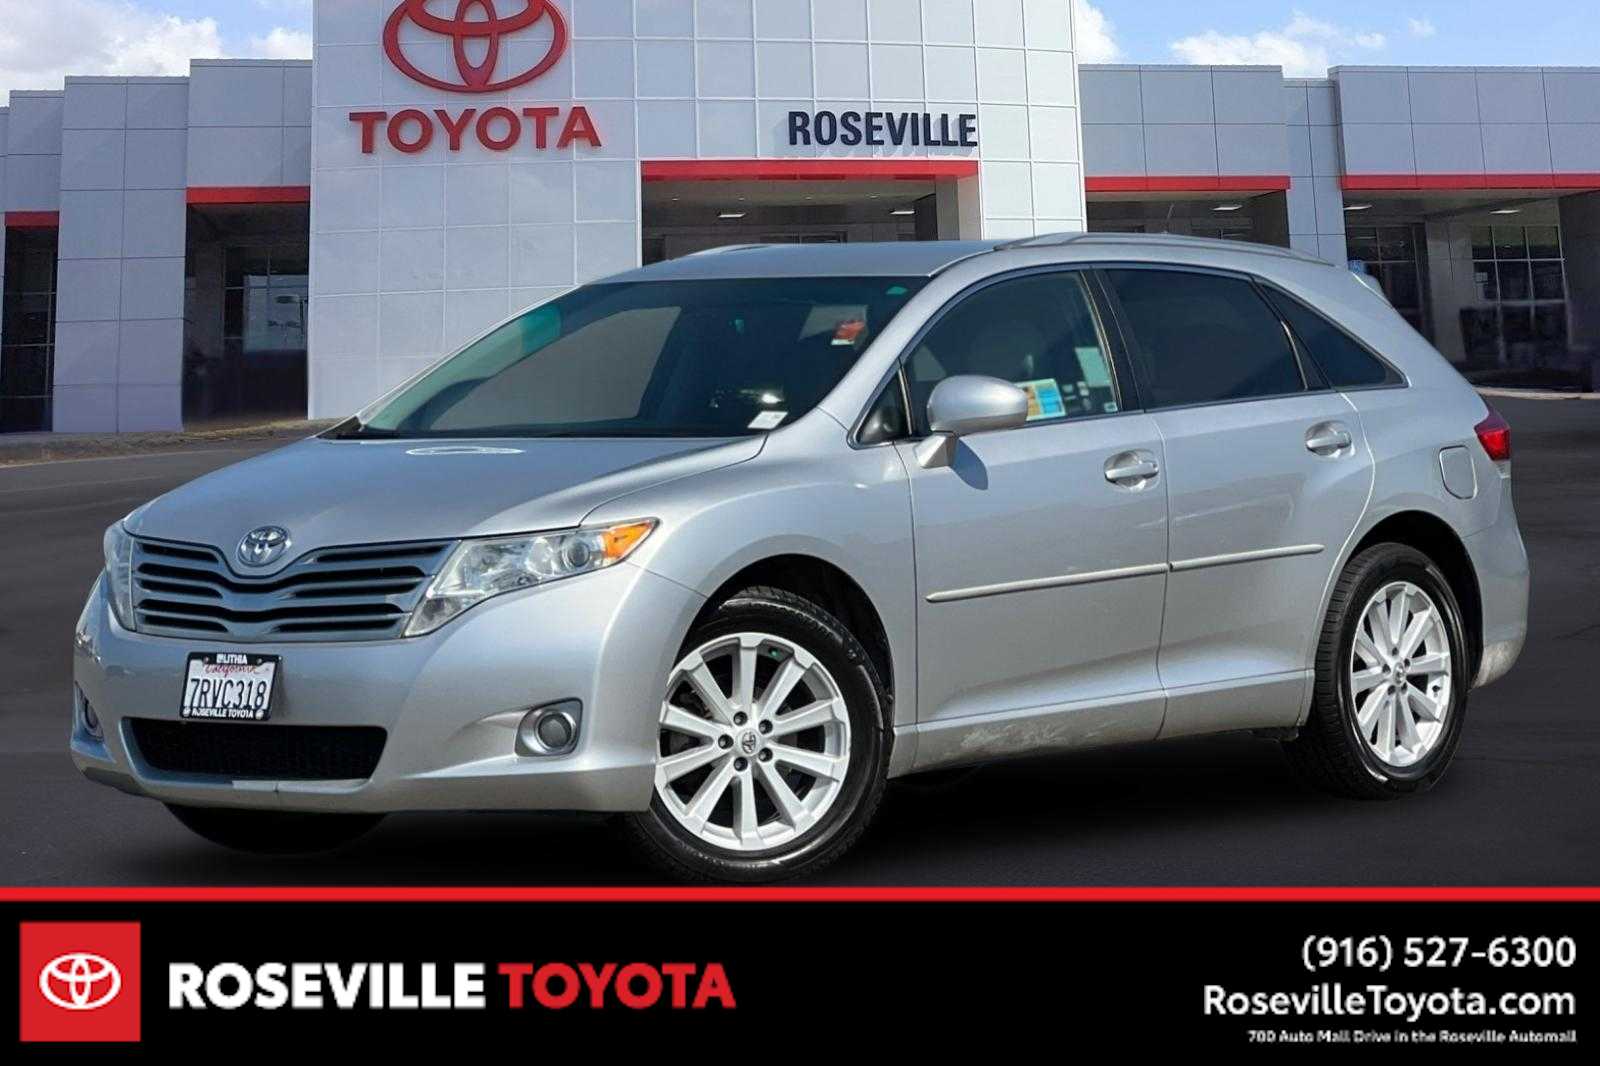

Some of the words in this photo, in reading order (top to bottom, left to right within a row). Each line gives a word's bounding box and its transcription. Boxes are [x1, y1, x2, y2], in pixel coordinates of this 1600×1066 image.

[349, 106, 602, 153] TOYOTA
[788, 111, 978, 147] ROSEVILLE
[190, 678, 267, 710] 7RVC318
[228, 708, 254, 719] TOYOTA
